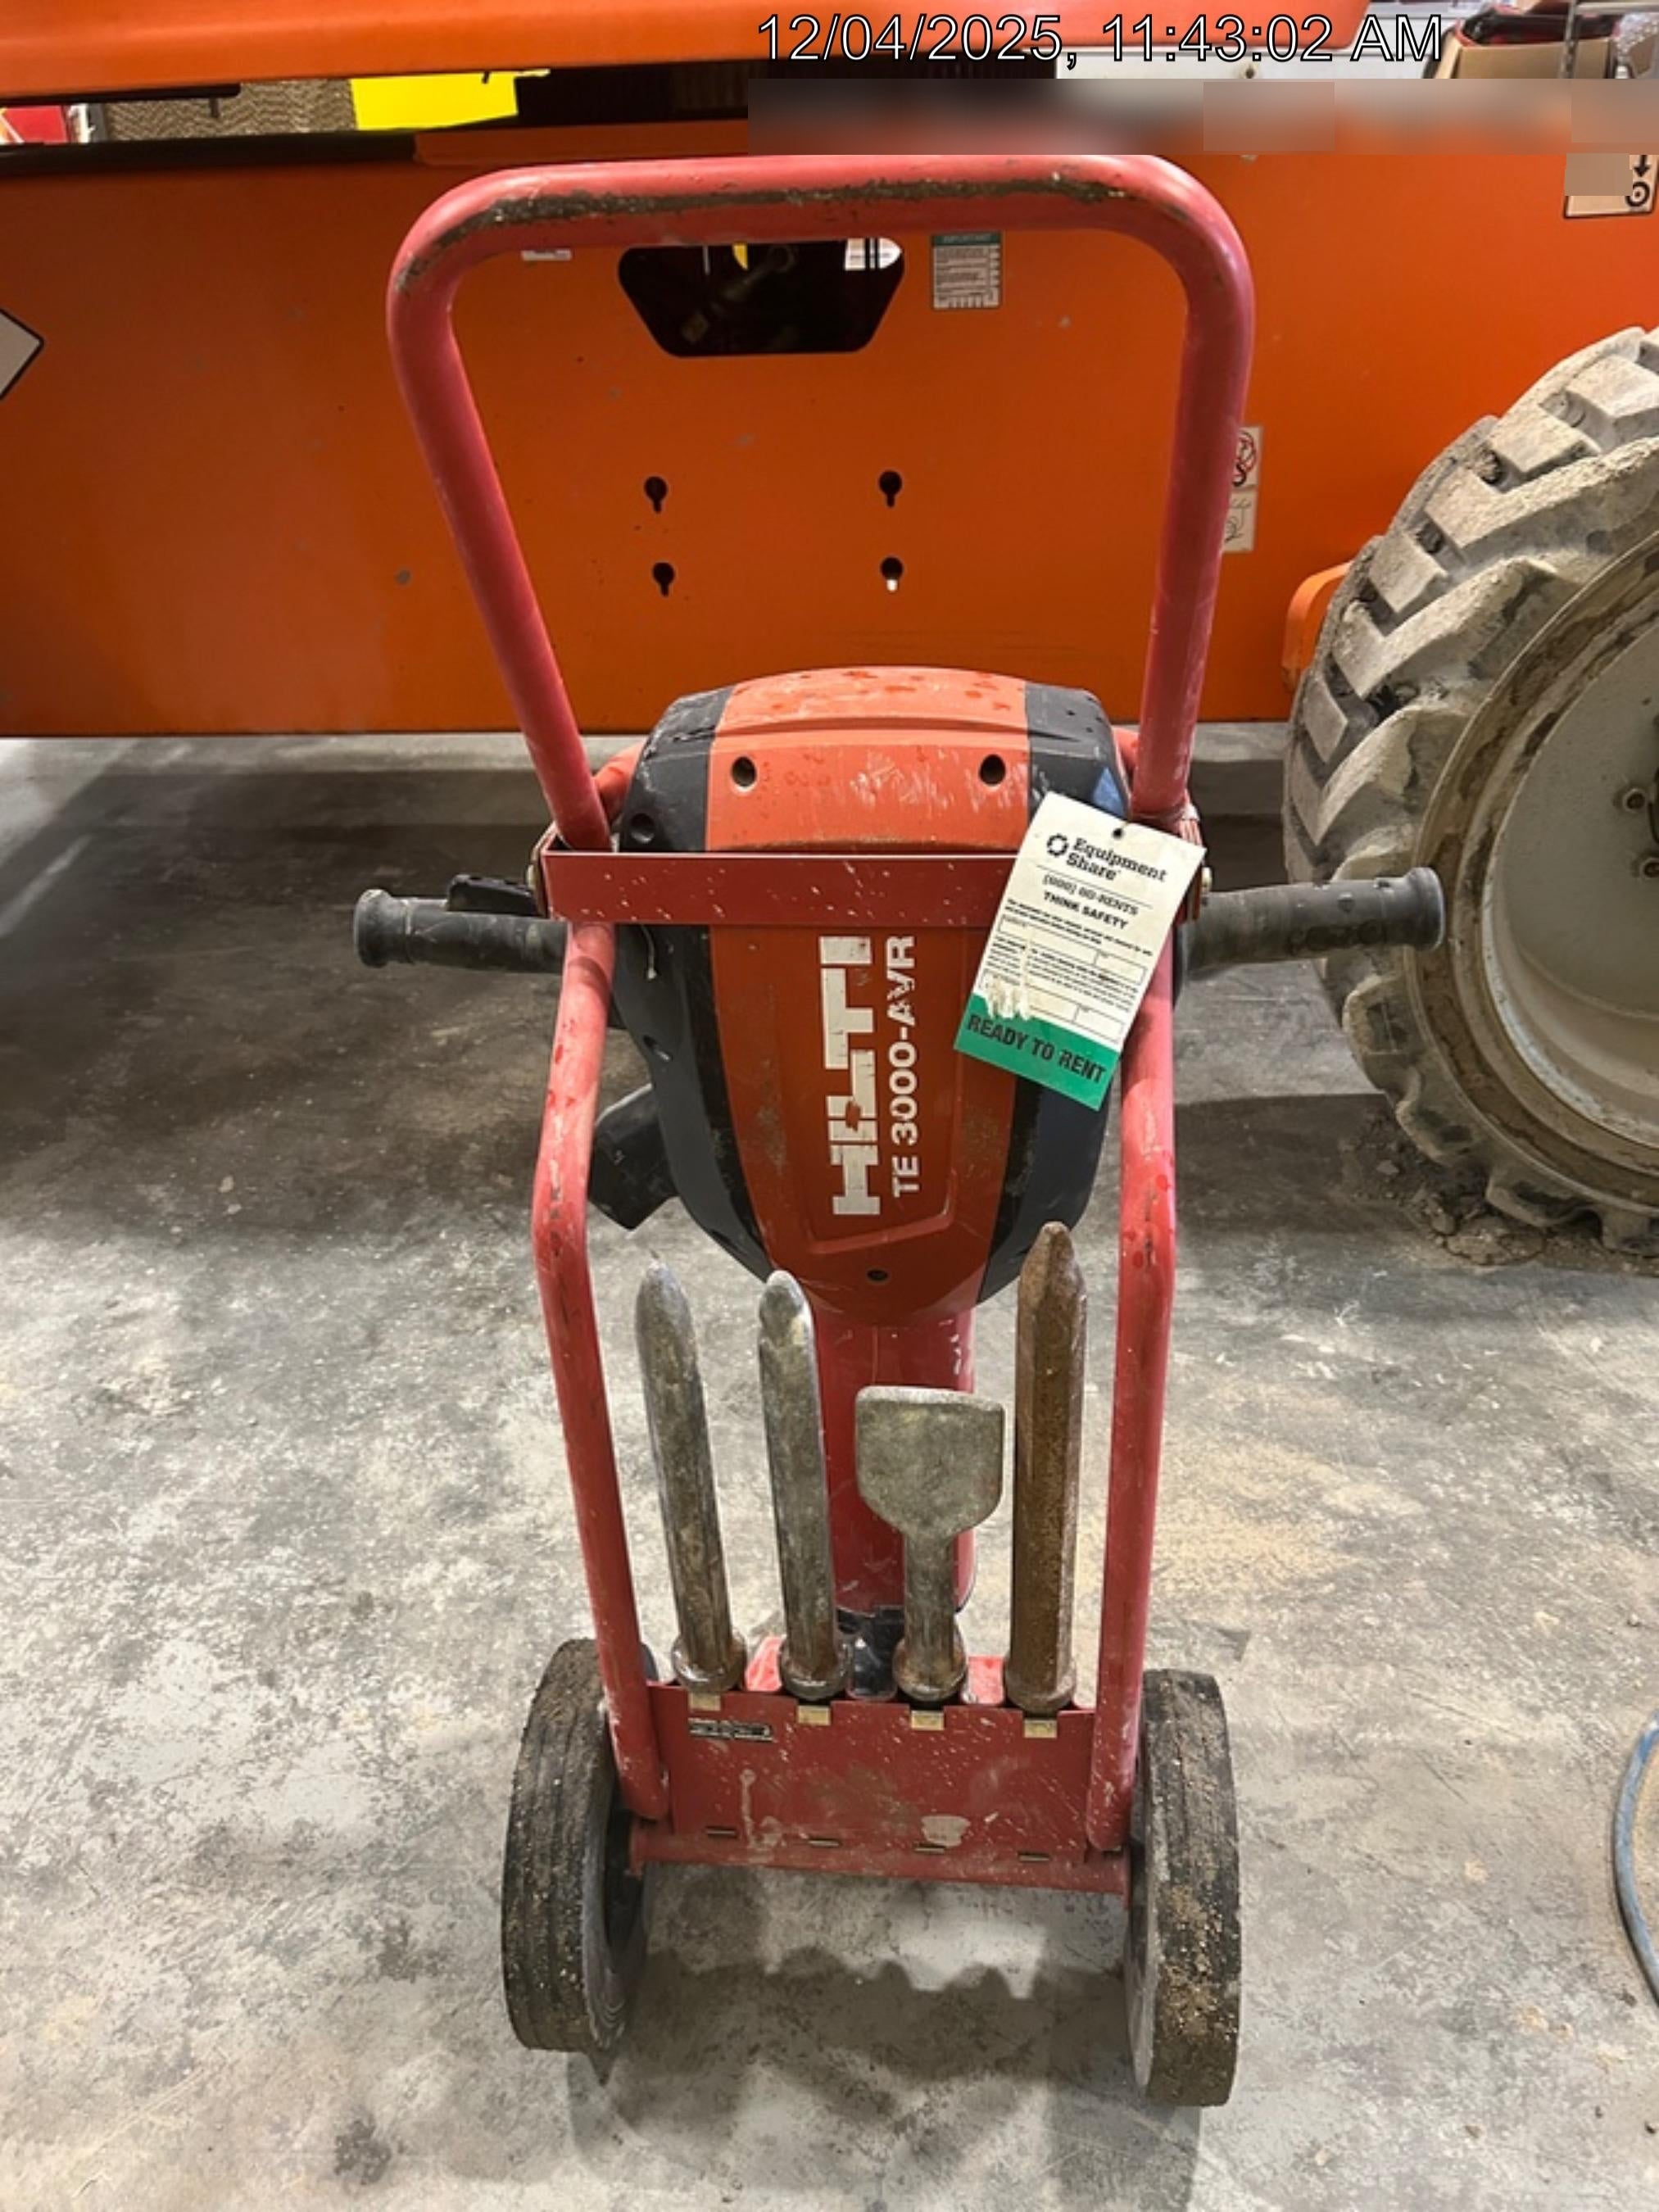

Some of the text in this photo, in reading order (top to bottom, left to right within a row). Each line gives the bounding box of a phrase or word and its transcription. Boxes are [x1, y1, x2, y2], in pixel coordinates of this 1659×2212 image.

[1066, 852, 1117, 881] Share
[1073, 837, 1167, 882] Equipment
[1043, 891, 1129, 929] THINK SAFETY
[819, 936, 881, 1216] HILTI
[886, 935, 920, 1199] TE 3000-AVR
[968, 1014, 1106, 1083] READY TO RENT
